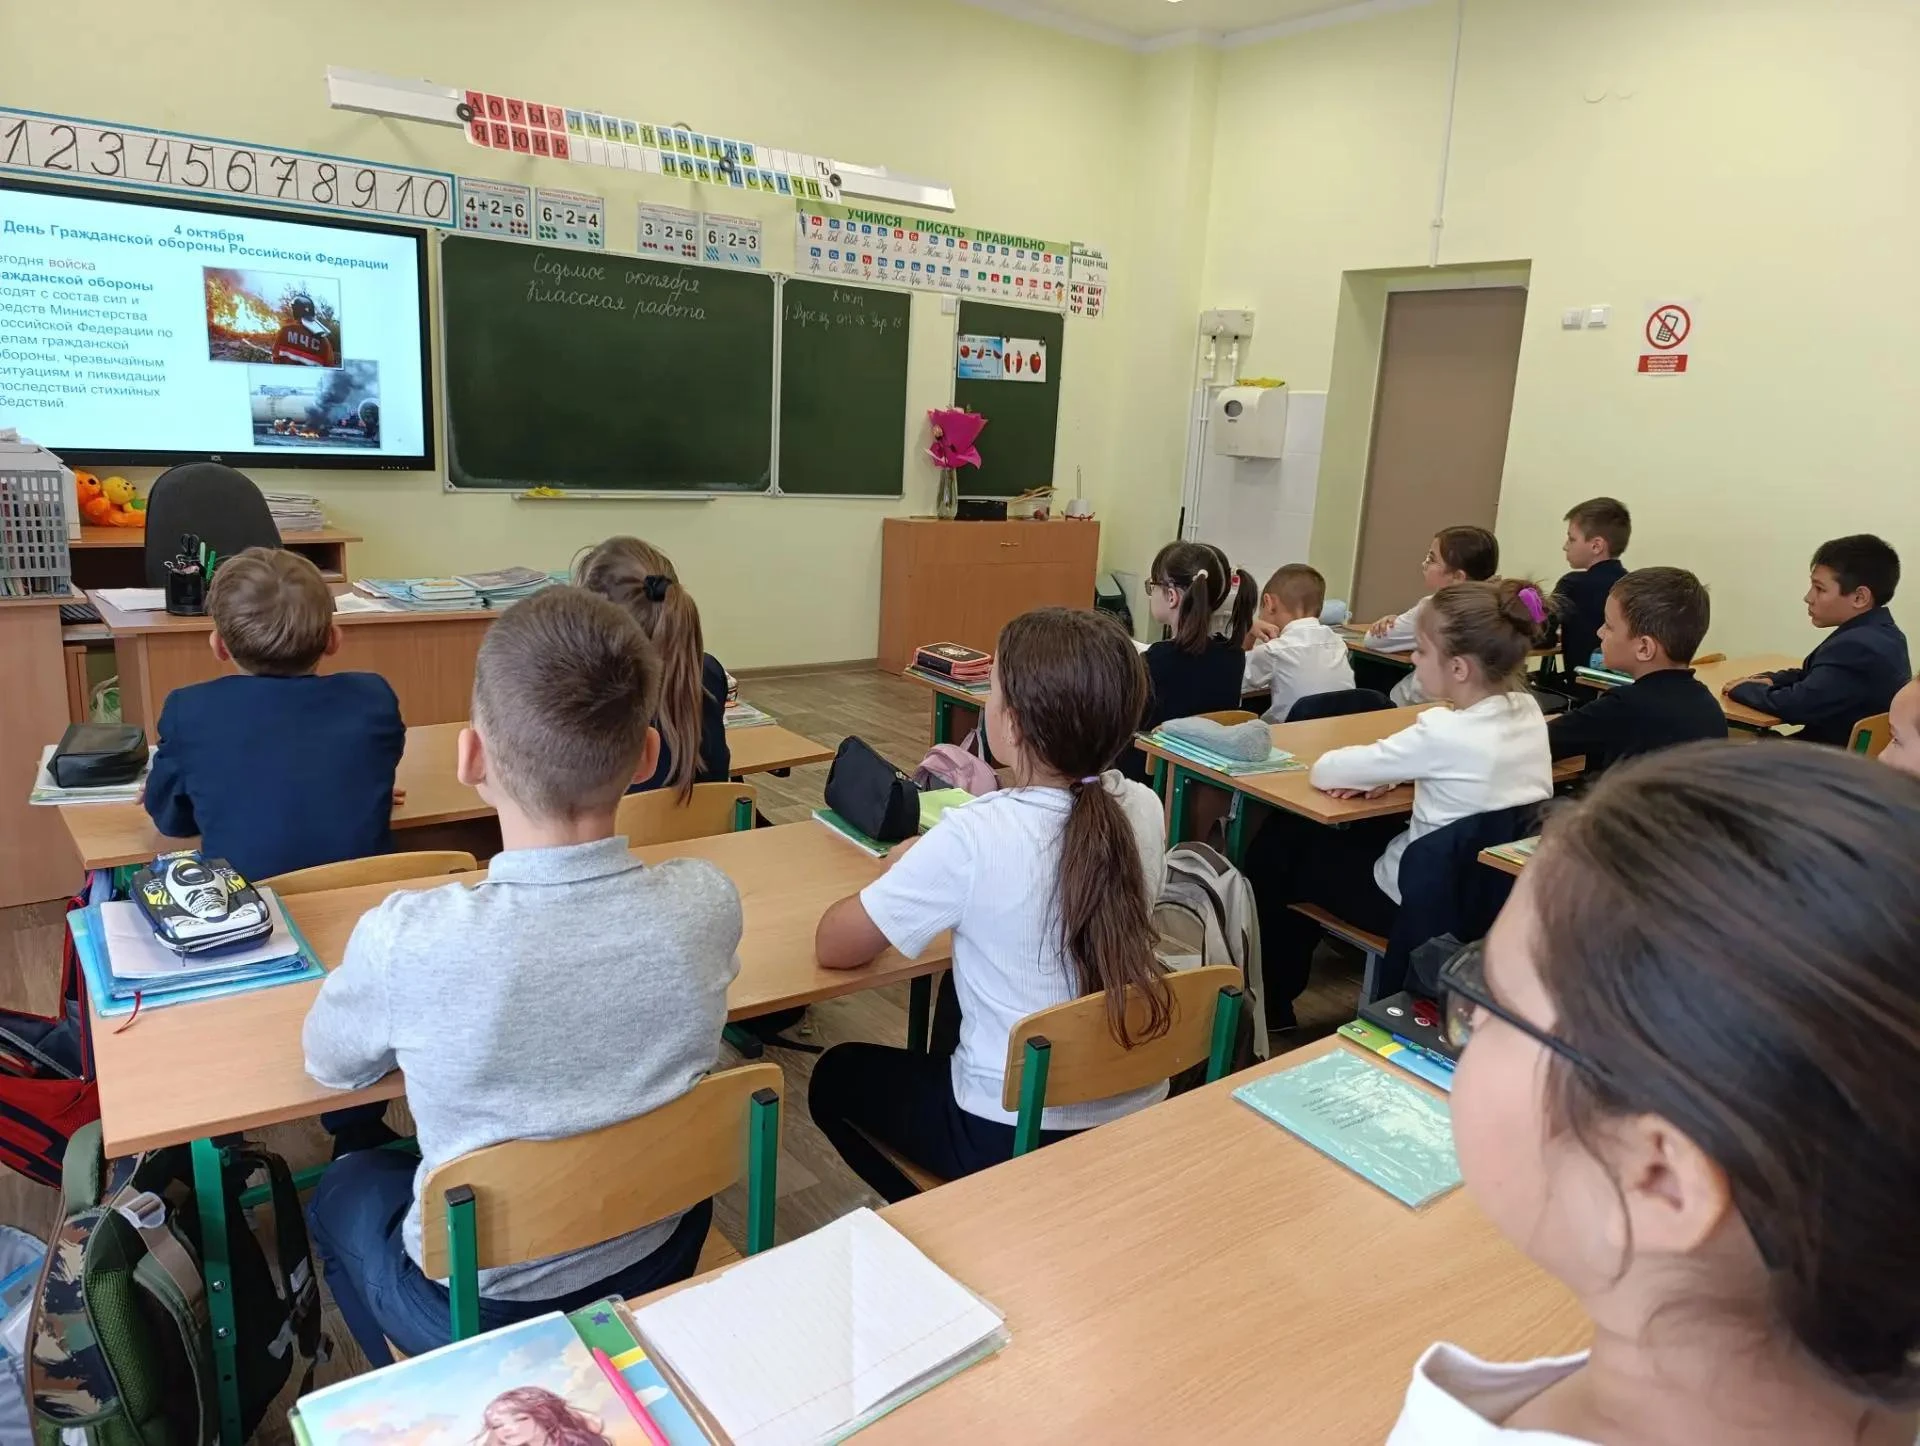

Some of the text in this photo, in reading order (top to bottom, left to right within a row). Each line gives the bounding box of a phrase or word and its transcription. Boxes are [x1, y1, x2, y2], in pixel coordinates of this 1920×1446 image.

[472, 98, 830, 176] А О У Ы Э Л М Н Р Й Б В Г Д Ж З Ъ
[5, 120, 448, 218] 1 2 3 4 5 6 7 8 9 10
[174, 225, 245, 243] 4 октября
[848, 208, 902, 227] УЧИМСЯ
[916, 219, 965, 238] ПИСАТЬ
[976, 231, 1046, 252] ПРАВИЛЬНО
[4, 220, 389, 270] День Гражданской обороны Российской Федерации
[49, 258, 96, 271] войска
[0, 271, 153, 291] ажданской обороны
[533, 253, 700, 300] Седьмое октября
[41, 290, 48, 299] с
[53, 291, 99, 303] состав
[103, 295, 127, 305] сил
[132, 297, 139, 305] и
[1071, 284, 1102, 295] ЖИ ШИ
[527, 280, 706, 319] Классная работа
[1071, 294, 1100, 307] ЧА ЩА
[50, 304, 148, 321] Министерства
[1070, 305, 1099, 317] ЧУ ЩУ
[77, 322, 153, 338] Федерации
[157, 329, 173, 339] по
[0, 335, 129, 351] елам гражданской
[287, 331, 321, 352] МЧС
[0, 349, 165, 368] бороны, чрезвычайным
[75, 370, 83, 379] и
[88, 370, 166, 383] ликвидации
[91, 385, 160, 397] стихийных
